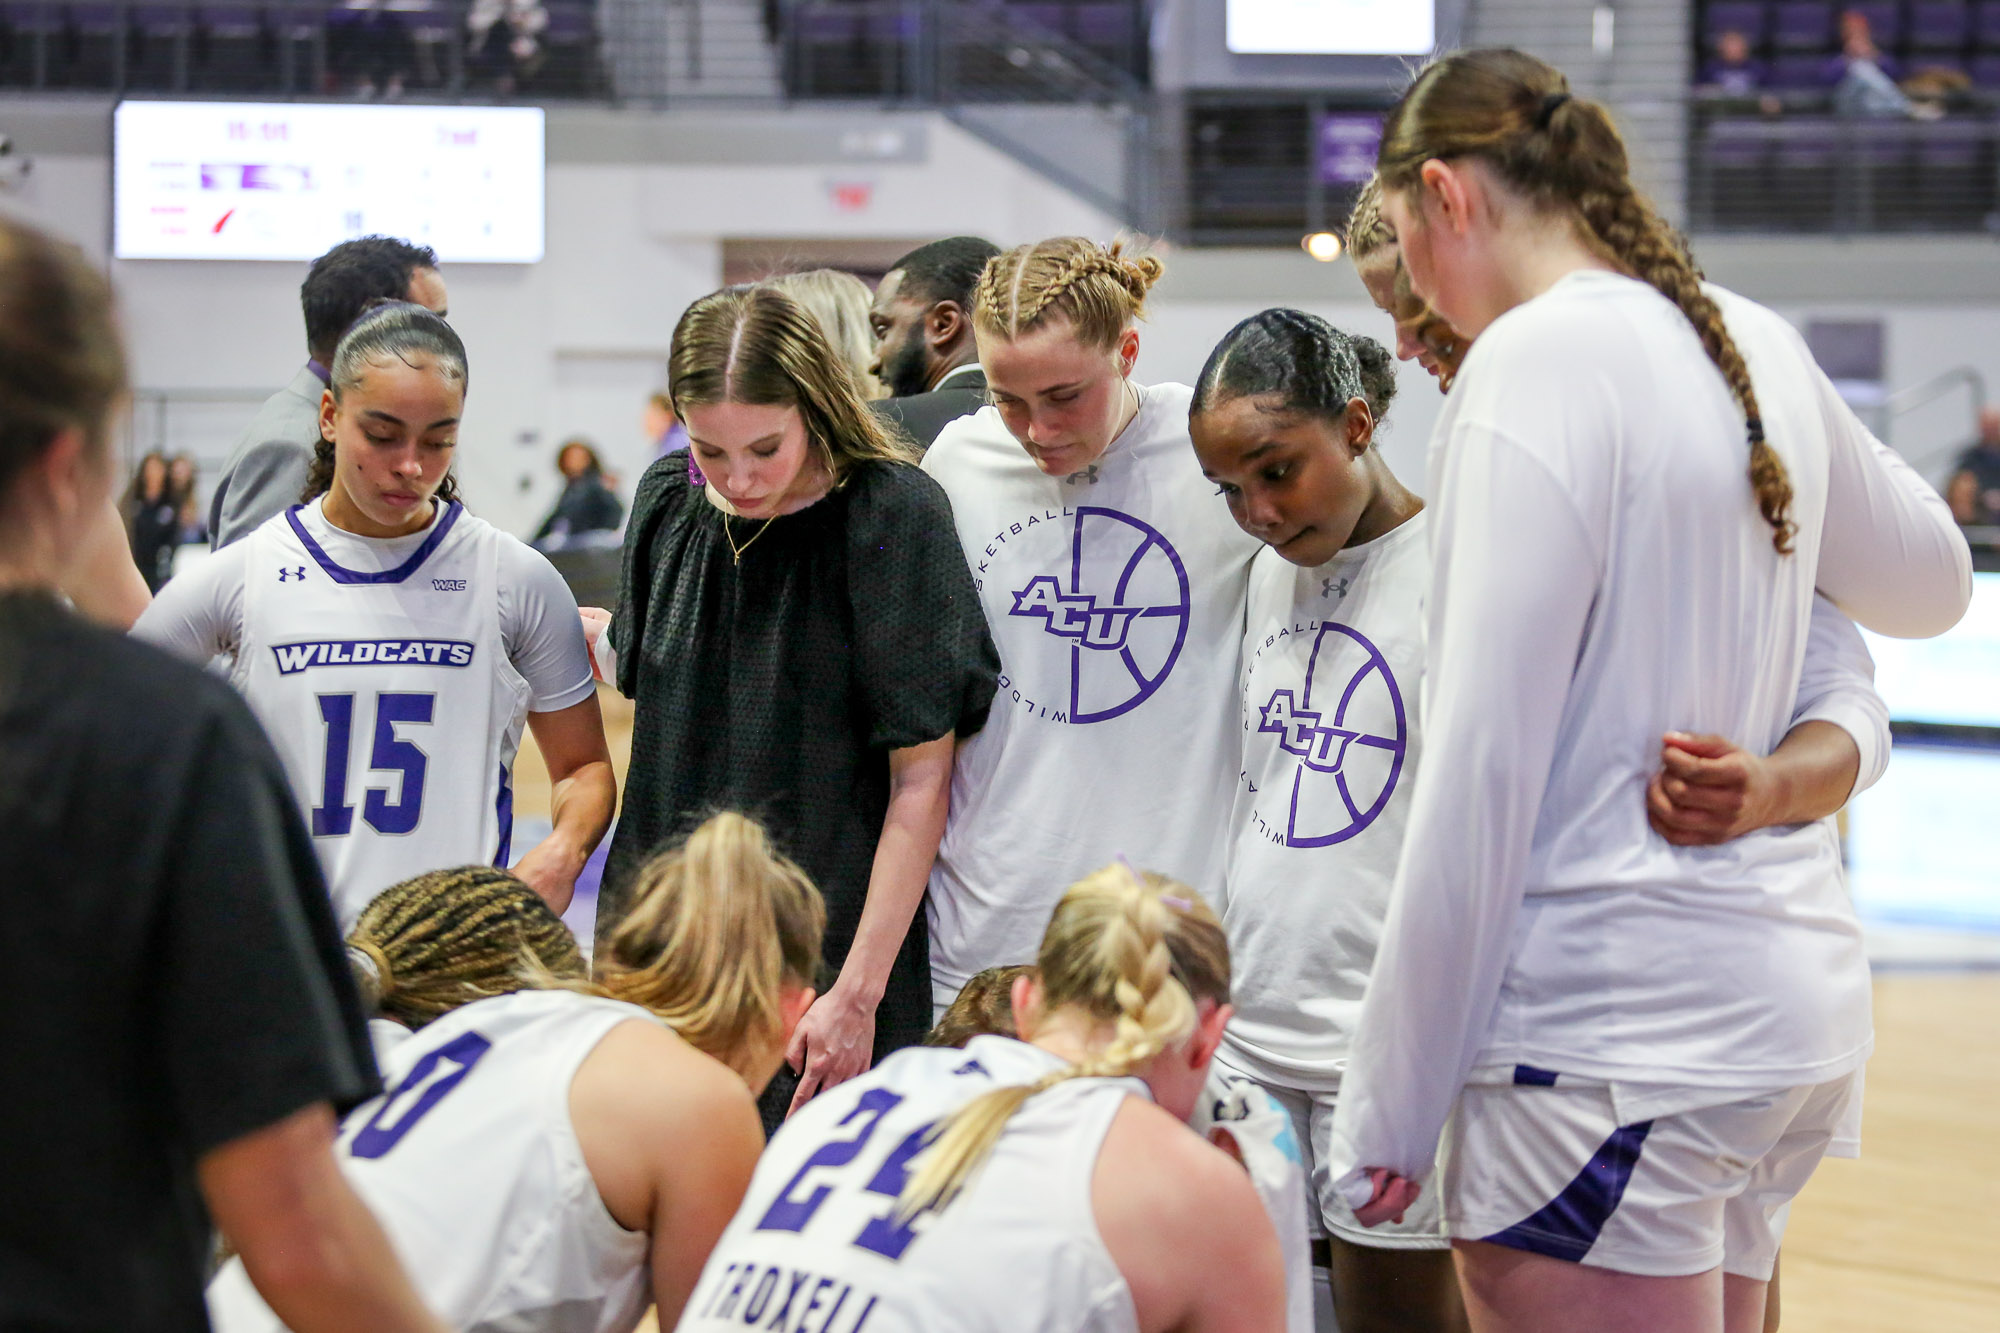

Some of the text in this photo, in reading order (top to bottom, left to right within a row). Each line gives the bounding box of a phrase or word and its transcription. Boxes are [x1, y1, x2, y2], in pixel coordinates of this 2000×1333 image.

[432, 579, 467, 591] WAC
[975, 506, 1073, 591] SKETBALL
[1010, 577, 1142, 649] ACU
[274, 641, 473, 673] WILDCATS
[998, 676, 1067, 723] WILDC
[1258, 689, 1359, 772] ACU
[312, 691, 437, 838] 15
[350, 1031, 492, 1159] 0
[754, 1087, 964, 1260] 24
